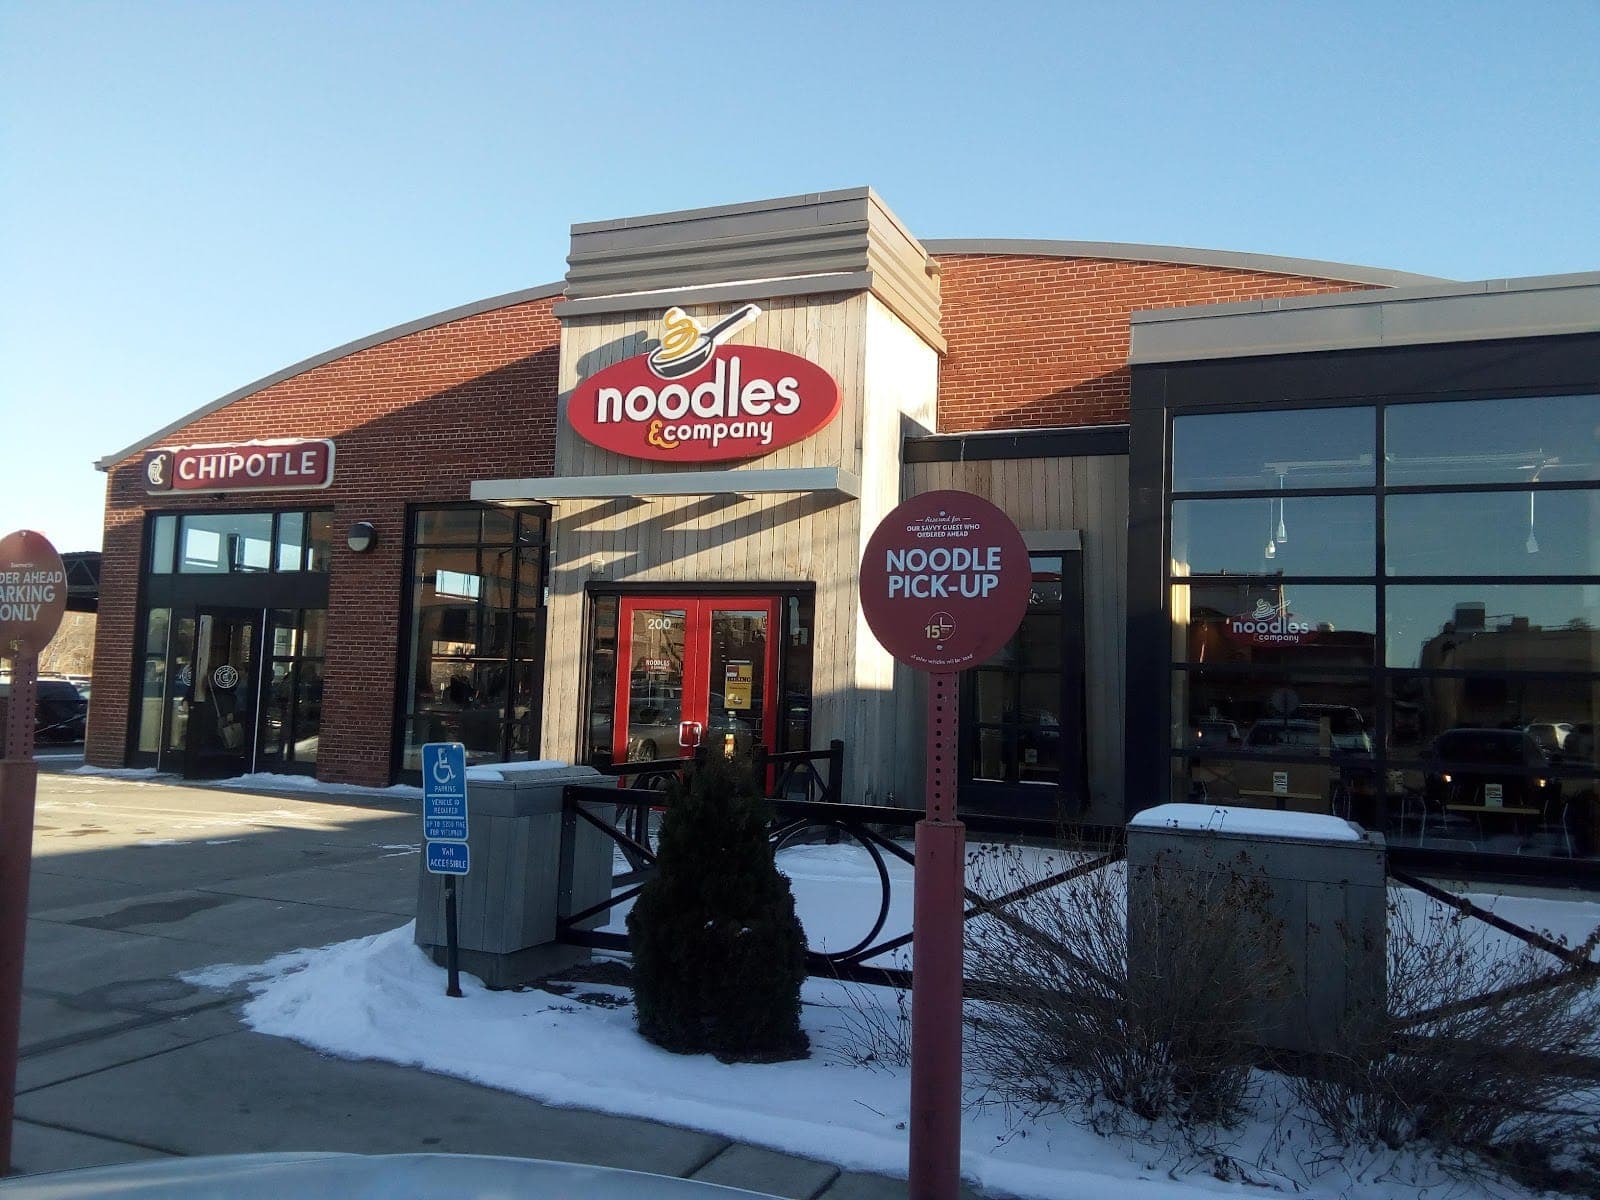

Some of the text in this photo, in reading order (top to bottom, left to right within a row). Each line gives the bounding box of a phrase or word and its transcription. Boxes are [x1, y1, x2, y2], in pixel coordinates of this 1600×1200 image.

[597, 356, 800, 423] noodles
[179, 451, 317, 480] CHIPOTLE
[921, 524, 941, 532] SAVVY
[886, 546, 1002, 572] NOODLE
[0, 571, 63, 584] DER AHEAD
[0, 585, 56, 602] ARKING
[888, 574, 999, 599] PICK-UP
[0, 603, 41, 621] ONLY
[647, 618, 672, 630] 200
[1232, 617, 1310, 634] noodles
[924, 625, 941, 639] 15
[434, 785, 457, 793] PARKING
[441, 847, 454, 857] VAN
[430, 858, 467, 869] ACCESSIBLE
